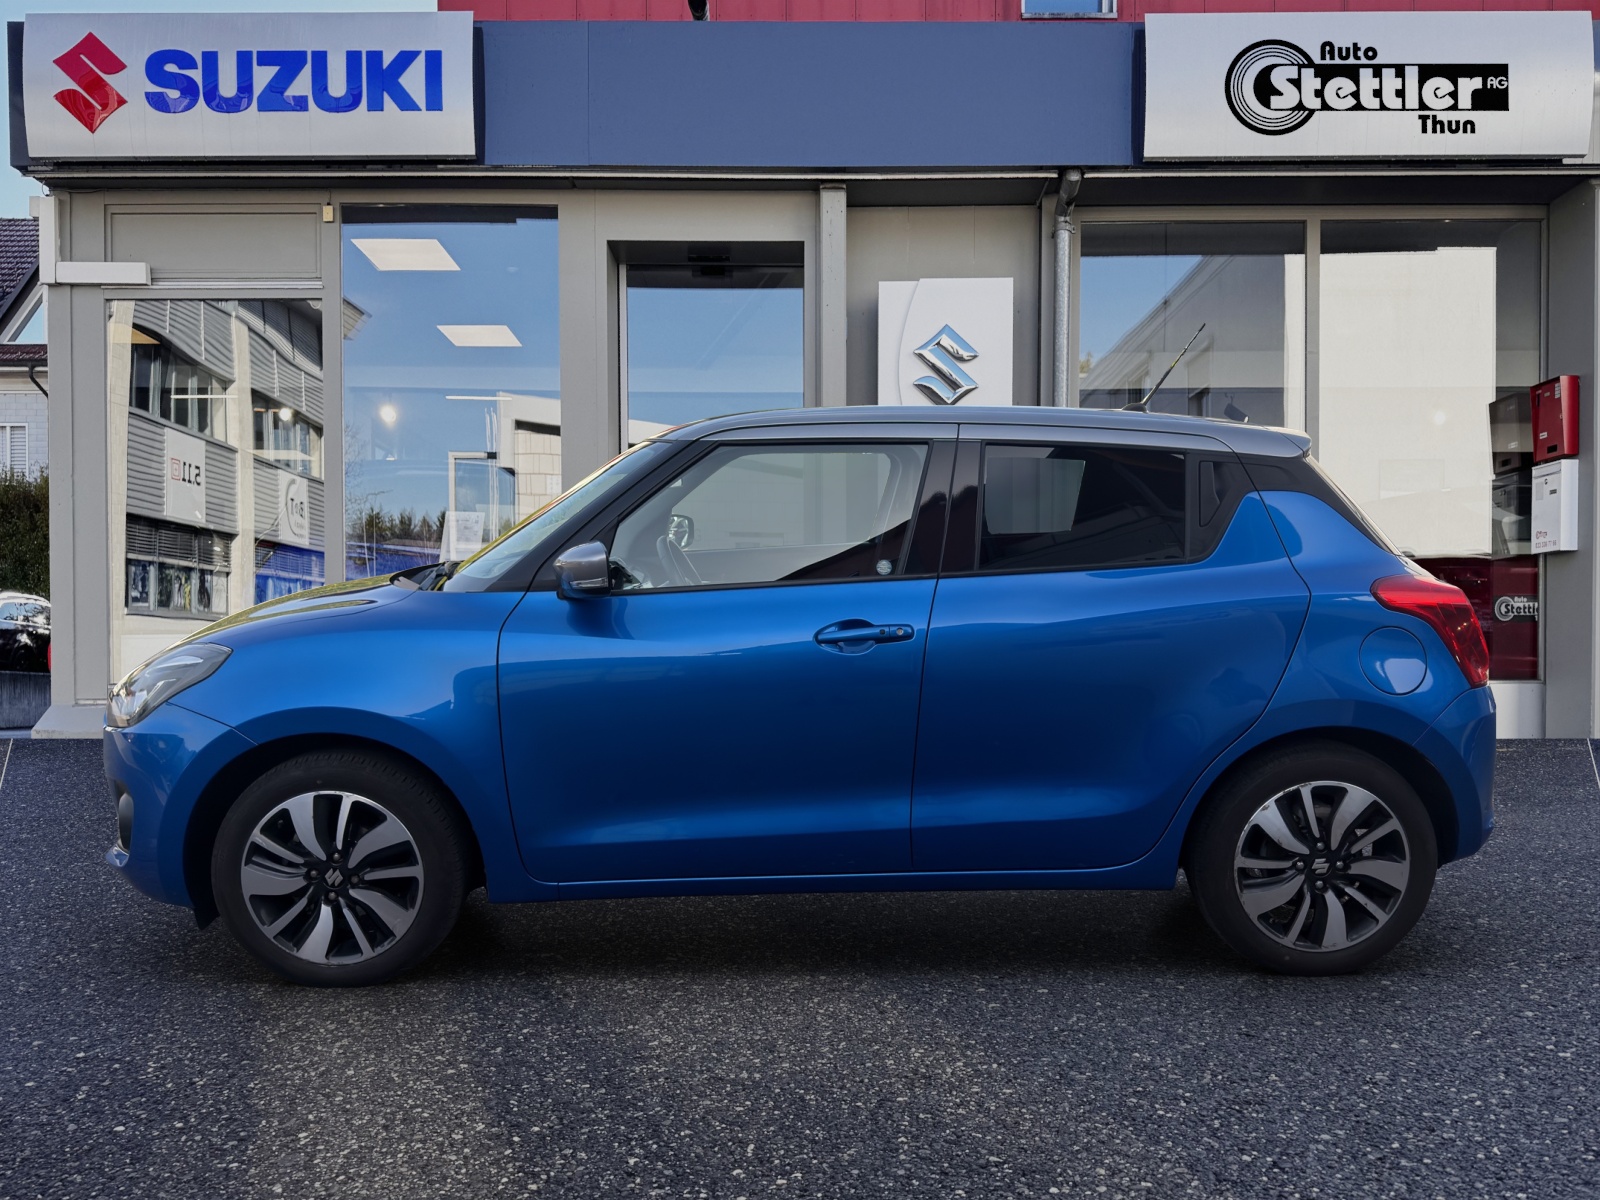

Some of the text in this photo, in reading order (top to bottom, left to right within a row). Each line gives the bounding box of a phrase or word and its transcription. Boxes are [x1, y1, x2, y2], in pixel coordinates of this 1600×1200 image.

[1320, 41, 1378, 61] Auto
[144, 49, 444, 114] SUZUKI
[1270, 65, 1509, 110] Stettler AG
[1418, 114, 1476, 134] Thun
